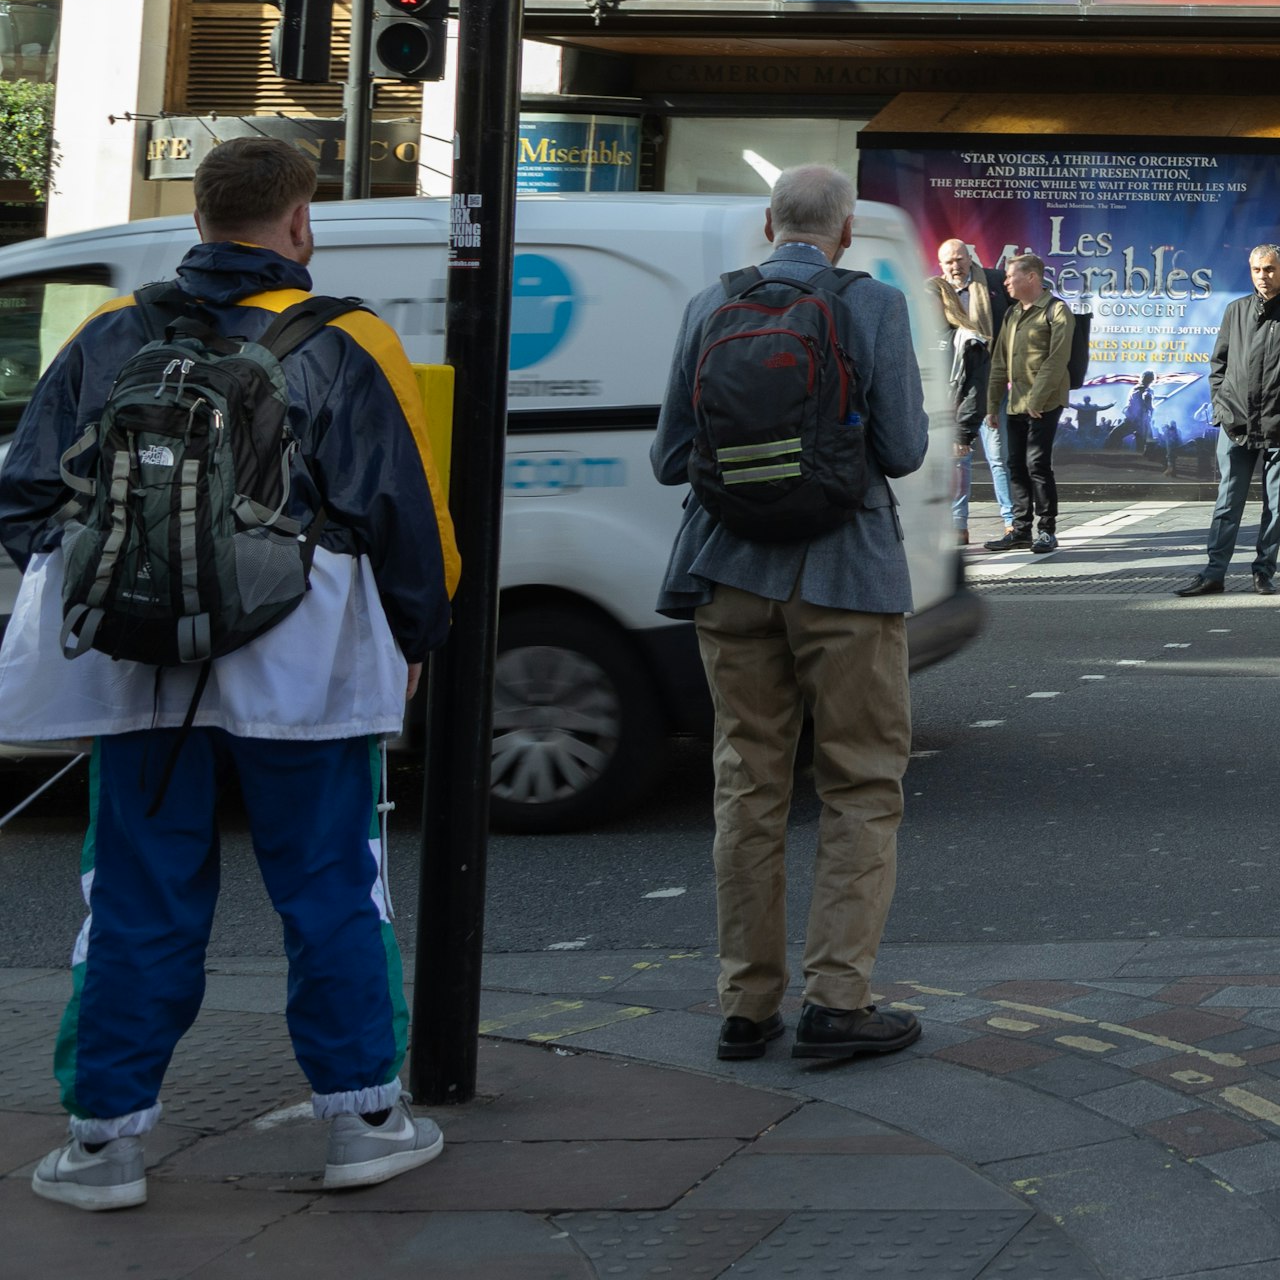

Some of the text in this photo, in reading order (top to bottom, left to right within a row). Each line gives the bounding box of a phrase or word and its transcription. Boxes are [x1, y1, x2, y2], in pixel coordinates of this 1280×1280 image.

[666, 64, 801, 85] CAMERON
[519, 138, 632, 166] Misérables
[998, 154, 1049, 166] VOICES,
[1051, 155, 1060, 166] A
[1063, 155, 1136, 167] THRILLING
[1139, 156, 1218, 168] ORCHESTRA
[986, 166, 1191, 180] AND BRILLIANT PRESENTATION.
[929, 178, 1247, 192] THE PERFECT TONIC WHILE WE WAIT FOR THE FULL LES MIS
[954, 189, 1013, 200] SPECTACLE
[1015, 190, 1031, 200] TO
[1033, 190, 1077, 200] RETURN
[1080, 191, 1095, 201] TO
[1097, 191, 1171, 202] SHAFTESBURY
[453, 235, 481, 248] TOUR
[1048, 215, 1113, 257] Les
[963, 244, 1213, 301] sérables
[1099, 302, 1187, 318] CONCERT
[1102, 325, 1143, 335] THEATRE
[1147, 326, 1176, 335] UNTIL
[1178, 326, 1201, 335] 30TH
[1120, 339, 1157, 351] SOLD
[1159, 340, 1188, 351] OUT
[1089, 351, 1210, 364] AILY FOR RETURNS
[149, 444, 163, 454] THE
